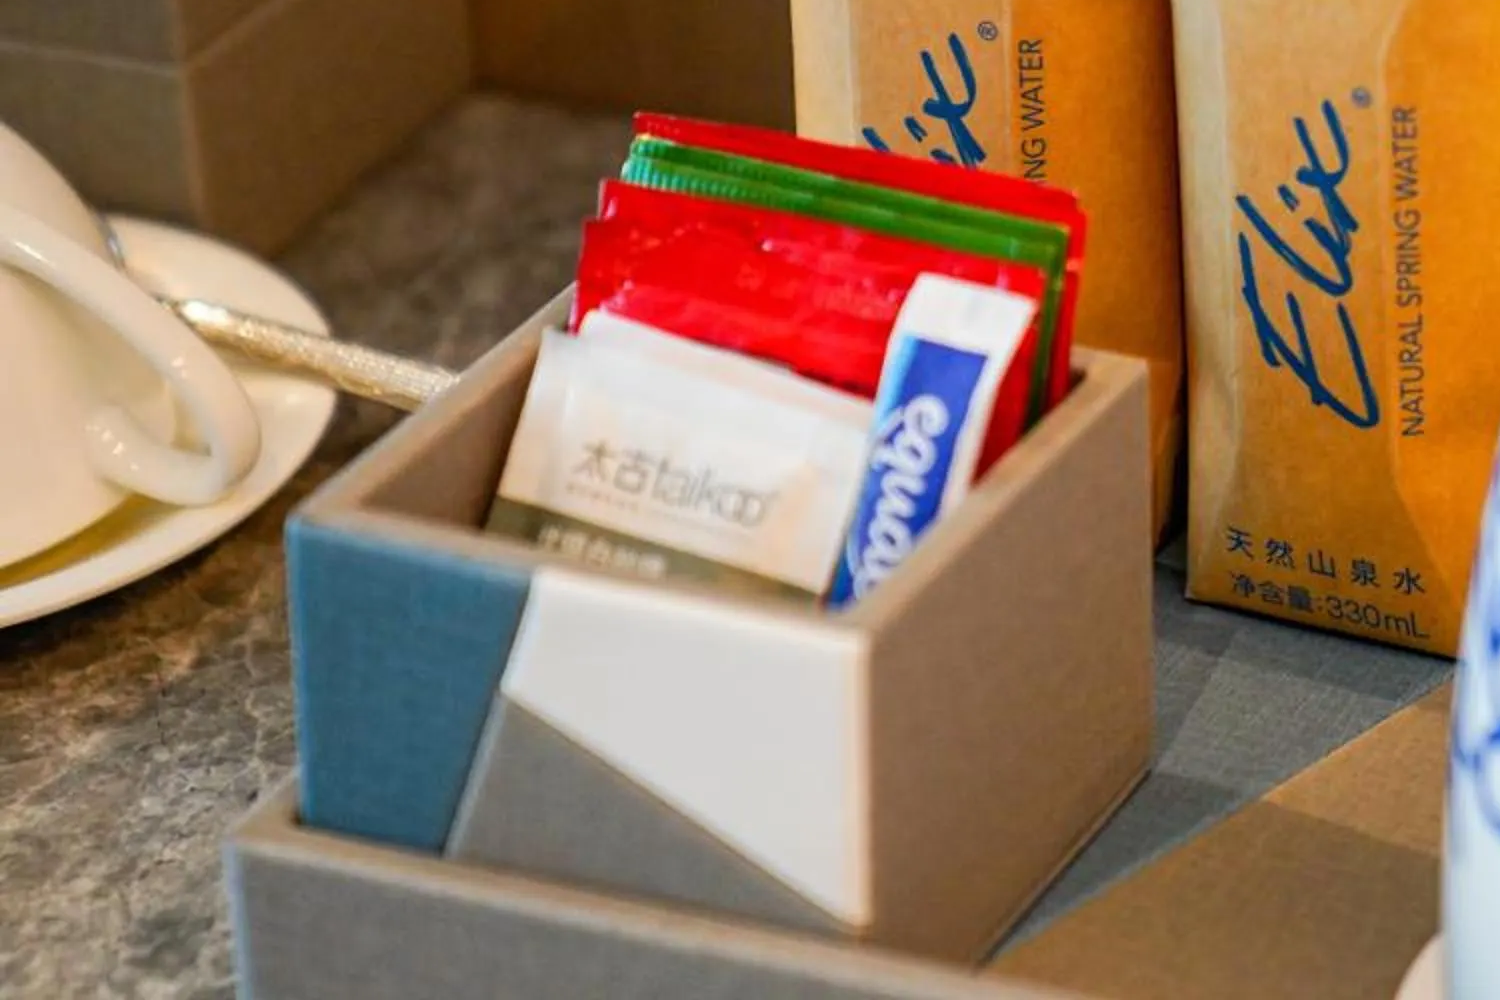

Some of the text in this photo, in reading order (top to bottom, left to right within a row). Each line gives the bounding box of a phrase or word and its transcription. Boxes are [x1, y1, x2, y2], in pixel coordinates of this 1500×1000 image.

[1017, 38, 1046, 132] WATER
[1391, 105, 1426, 438] NATURAL SPRING WATER
[1226, 525, 1425, 596] 天然山泉水
